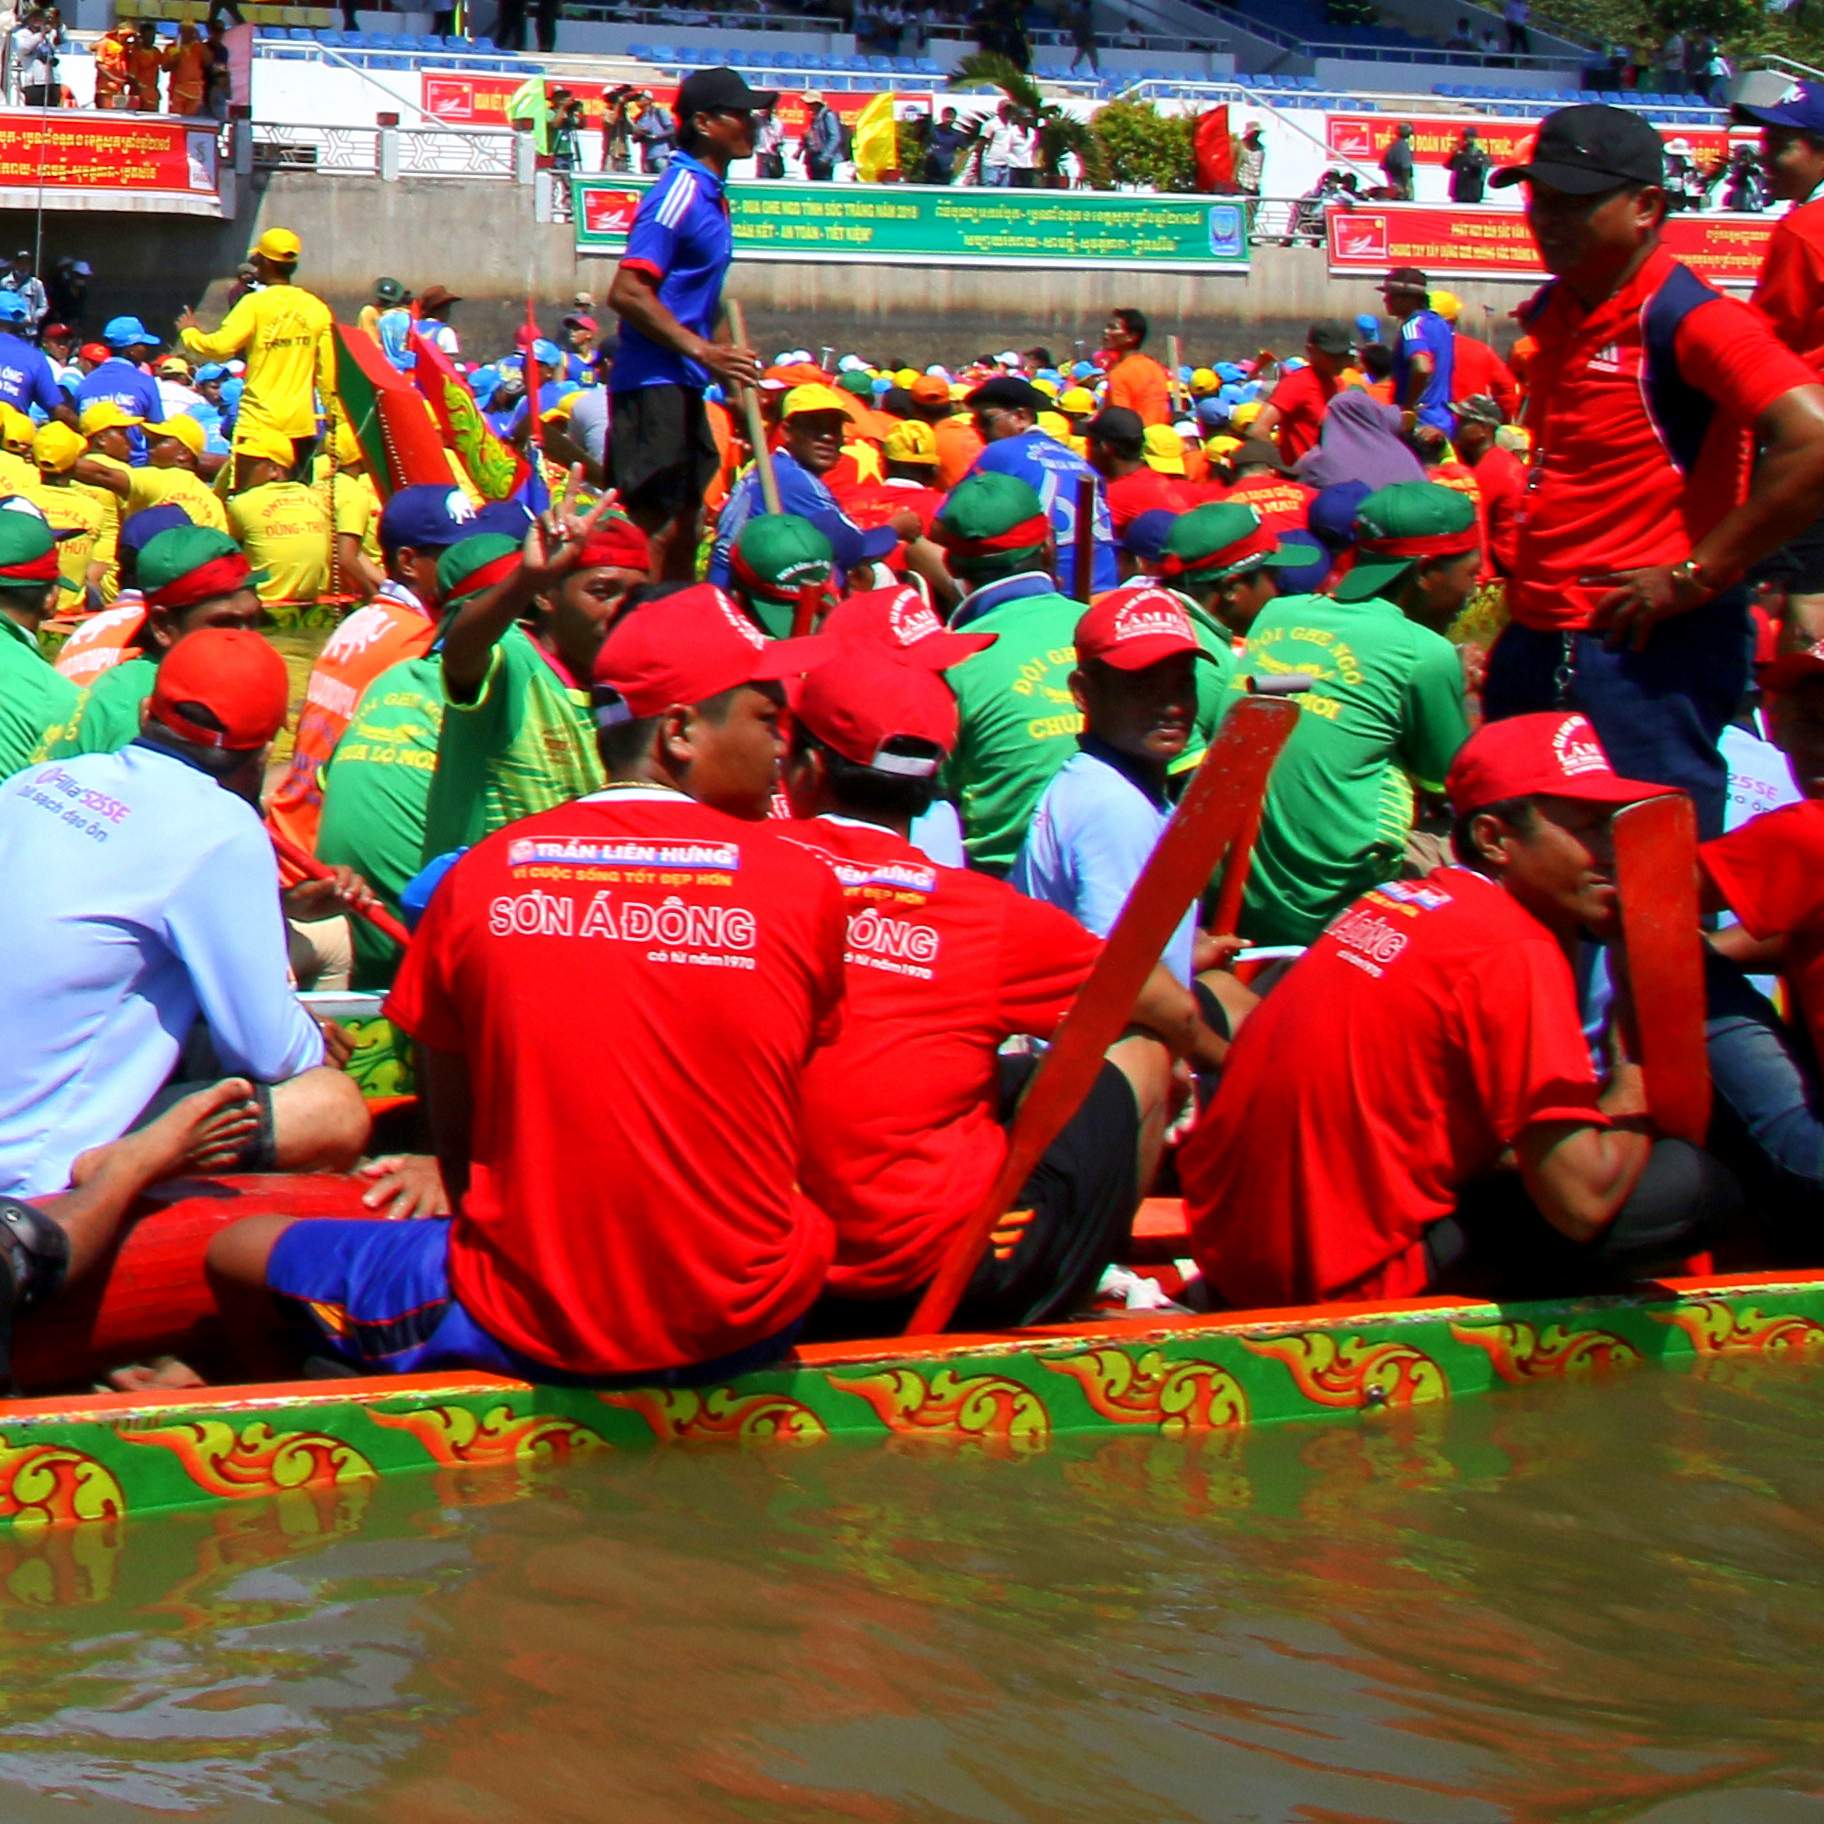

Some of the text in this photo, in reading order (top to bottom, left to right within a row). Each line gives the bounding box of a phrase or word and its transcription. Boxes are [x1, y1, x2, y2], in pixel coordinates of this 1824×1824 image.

[599, 842, 657, 863] LIÊN
[529, 866, 573, 881] CUỘC
[575, 867, 620, 883] SỐNG
[624, 870, 656, 884] TỐT
[659, 873, 693, 887] ĐẸP
[696, 872, 734, 887] HƠN
[488, 889, 756, 950] SƠN Á ĐÔNG
[846, 907, 939, 963] ÔNG
